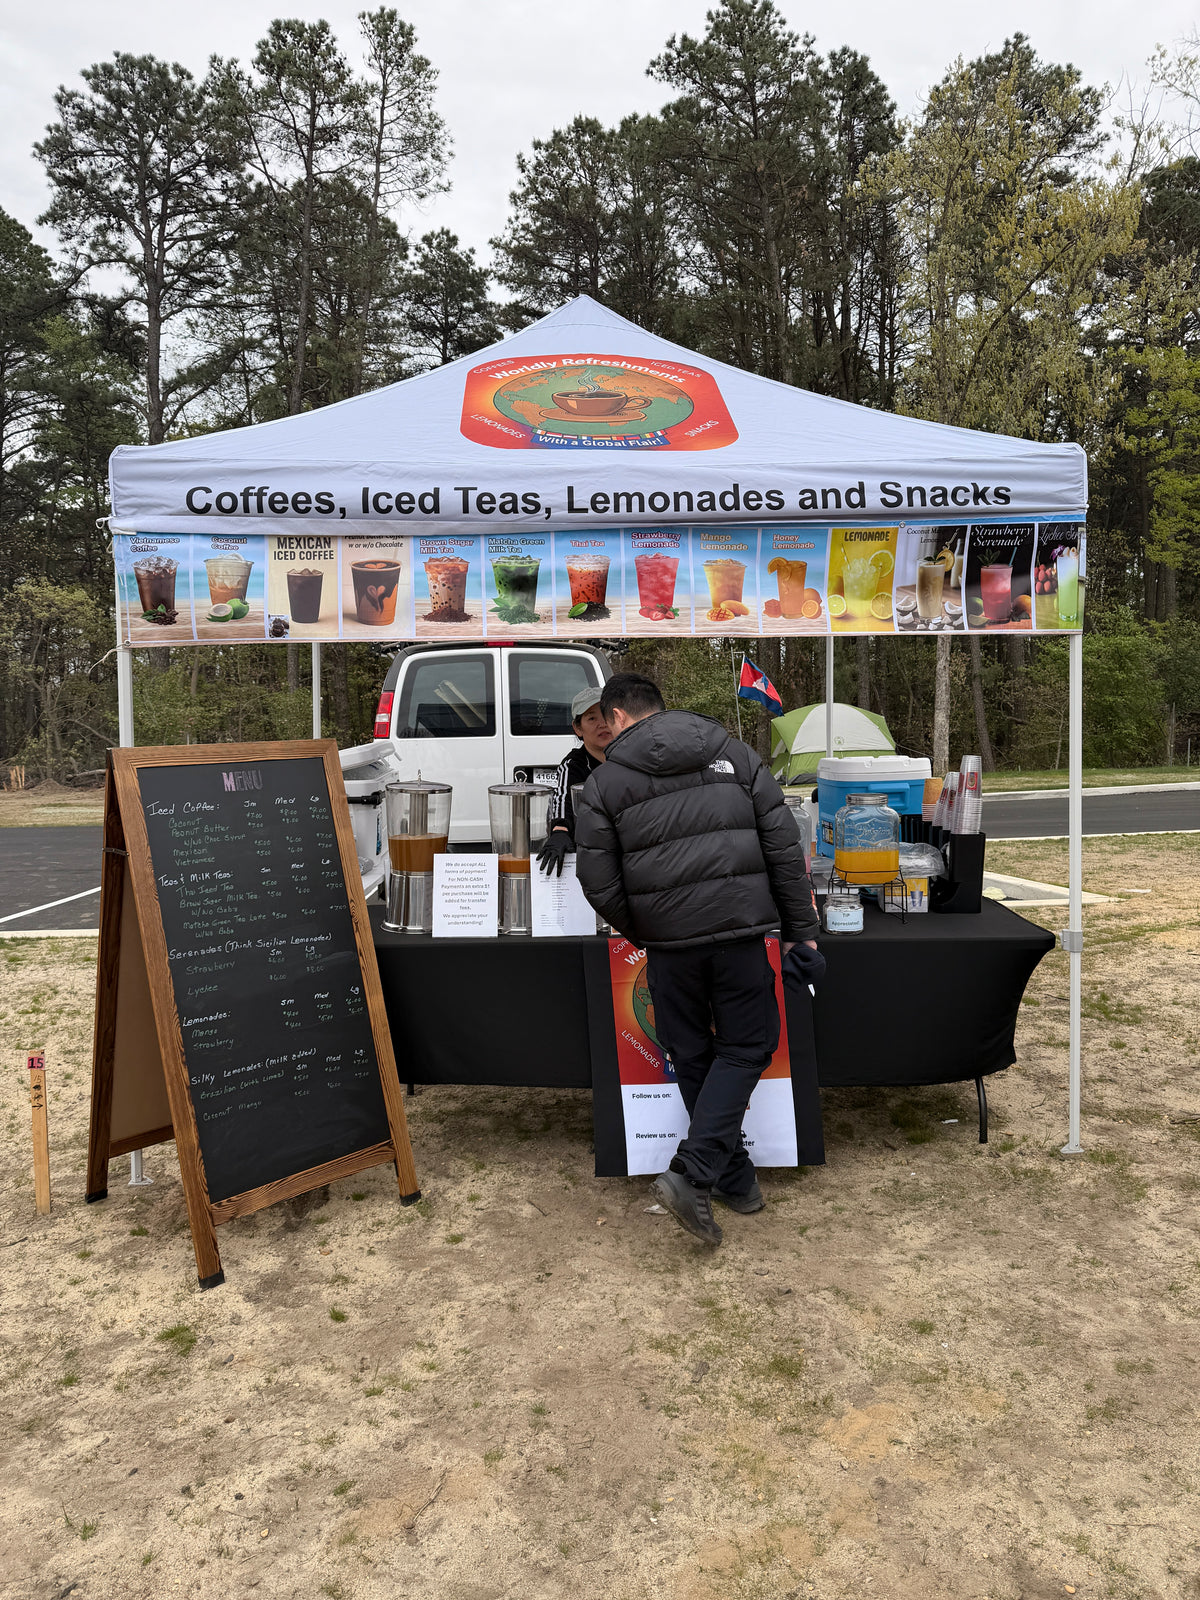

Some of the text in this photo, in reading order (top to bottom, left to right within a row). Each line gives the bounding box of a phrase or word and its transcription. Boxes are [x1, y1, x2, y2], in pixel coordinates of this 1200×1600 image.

[473, 360, 515, 374] COFFEES
[488, 357, 686, 383] Worldly Refreshments
[650, 360, 703, 378] ICED TEAS
[470, 413, 526, 439] LEMONADES
[684, 419, 720, 437] SNACKS
[539, 435, 568, 446] With
[582, 439, 627, 447] Global
[628, 437, 664, 447] Flair!
[185, 481, 1012, 520] Coffees, Iced Teas, Lemonades and Snacks
[631, 532, 682, 541] Strawberry
[700, 533, 732, 542] Mango
[844, 531, 891, 542] LEMONADE
[971, 525, 1034, 538] Strawberry
[130, 537, 181, 545] Vietnamese
[211, 536, 248, 544] Coconut
[276, 536, 332, 549] MEXICAN
[419, 538, 475, 547] Brown Sugar
[488, 537, 546, 546] Matcha Green
[773, 534, 799, 543] Honey
[973, 535, 1025, 546] Serenade
[211, 543, 239, 551] Coffee
[419, 546, 455, 554] Milk Tea
[488, 545, 523, 553] Milk Tea
[700, 543, 749, 551] Lemonade
[772, 542, 815, 550] Lemonade
[273, 550, 335, 560] ICED COFFEE
[221, 769, 263, 791] MENU
[146, 800, 175, 816] Iced
[183, 801, 220, 814] Coffee:
[168, 816, 202, 829] Coconut
[171, 823, 230, 838] Peanut Butter
[173, 848, 208, 857] Mexican
[175, 856, 216, 867] Vietnamese
[158, 873, 179, 887] Teas
[190, 872, 210, 882] Milk
[175, 885, 196, 897] Thai
[198, 884, 218, 894] Iced
[220, 881, 234, 891] Tea
[168, 945, 222, 960] Serenades
[255, 937, 286, 948] Sicilian
[612, 939, 630, 954] COFF
[186, 961, 235, 975] Strawberry
[191, 1029, 218, 1039] Mango
[193, 1038, 234, 1051] Strawberry
[621, 1030, 660, 1068] LEMONADES
[28, 1057, 43, 1069] 15
[203, 1106, 233, 1121] Coconut
